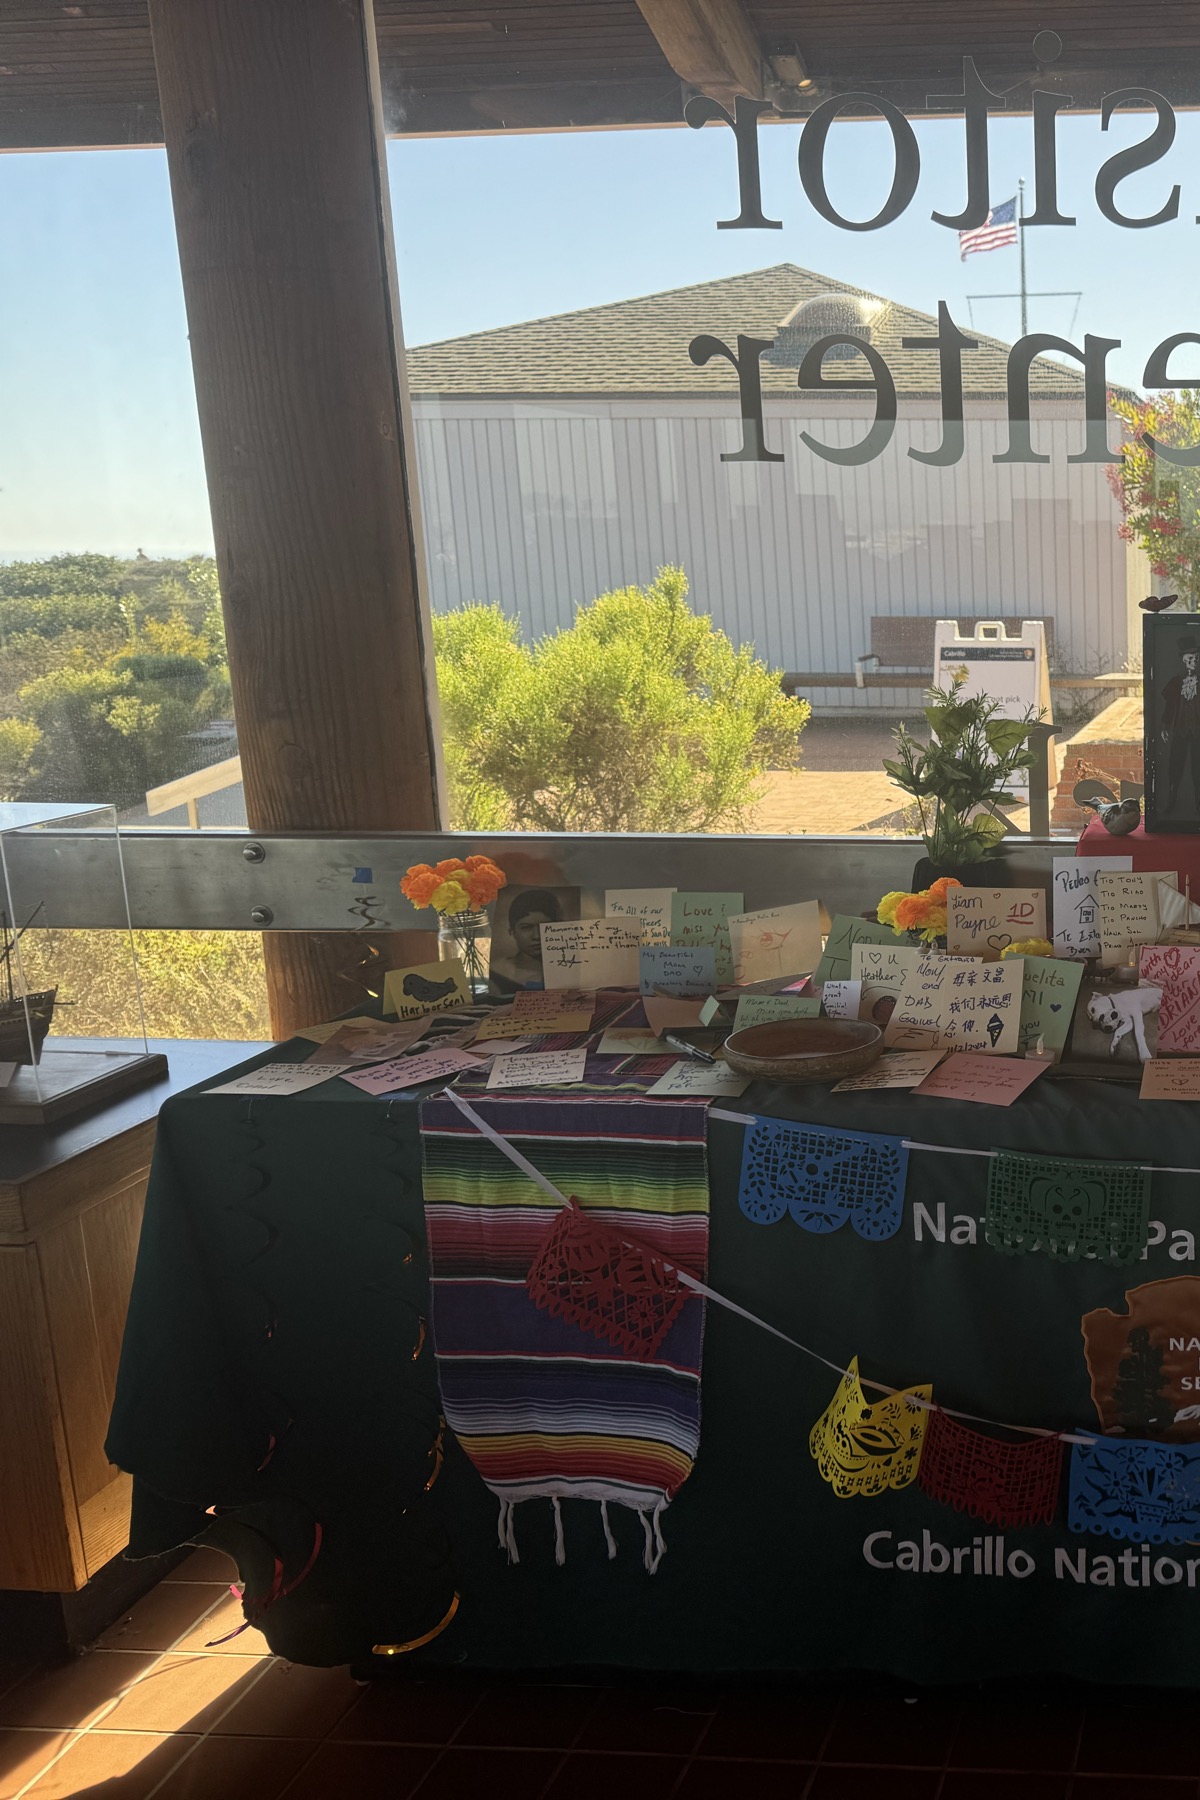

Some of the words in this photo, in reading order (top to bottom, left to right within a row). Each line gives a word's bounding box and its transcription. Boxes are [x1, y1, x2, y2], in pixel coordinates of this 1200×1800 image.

[1006, 696, 1020, 704] pick
[952, 894, 983, 909] Liam
[683, 902, 714, 917] Love
[545, 925, 584, 934] Memories
[590, 921, 602, 930] of
[606, 925, 622, 935] my
[683, 926, 704, 935] miss
[955, 914, 1001, 938] Payne
[609, 932, 640, 944] positive
[580, 942, 587, 950] I
[642, 952, 655, 962] My
[1141, 952, 1161, 977] with
[1170, 956, 1195, 982] dear
[400, 1003, 443, 1018] Harbor
[1022, 1021, 1040, 1034] you
[862, 1530, 1037, 1579] Cabrillo
